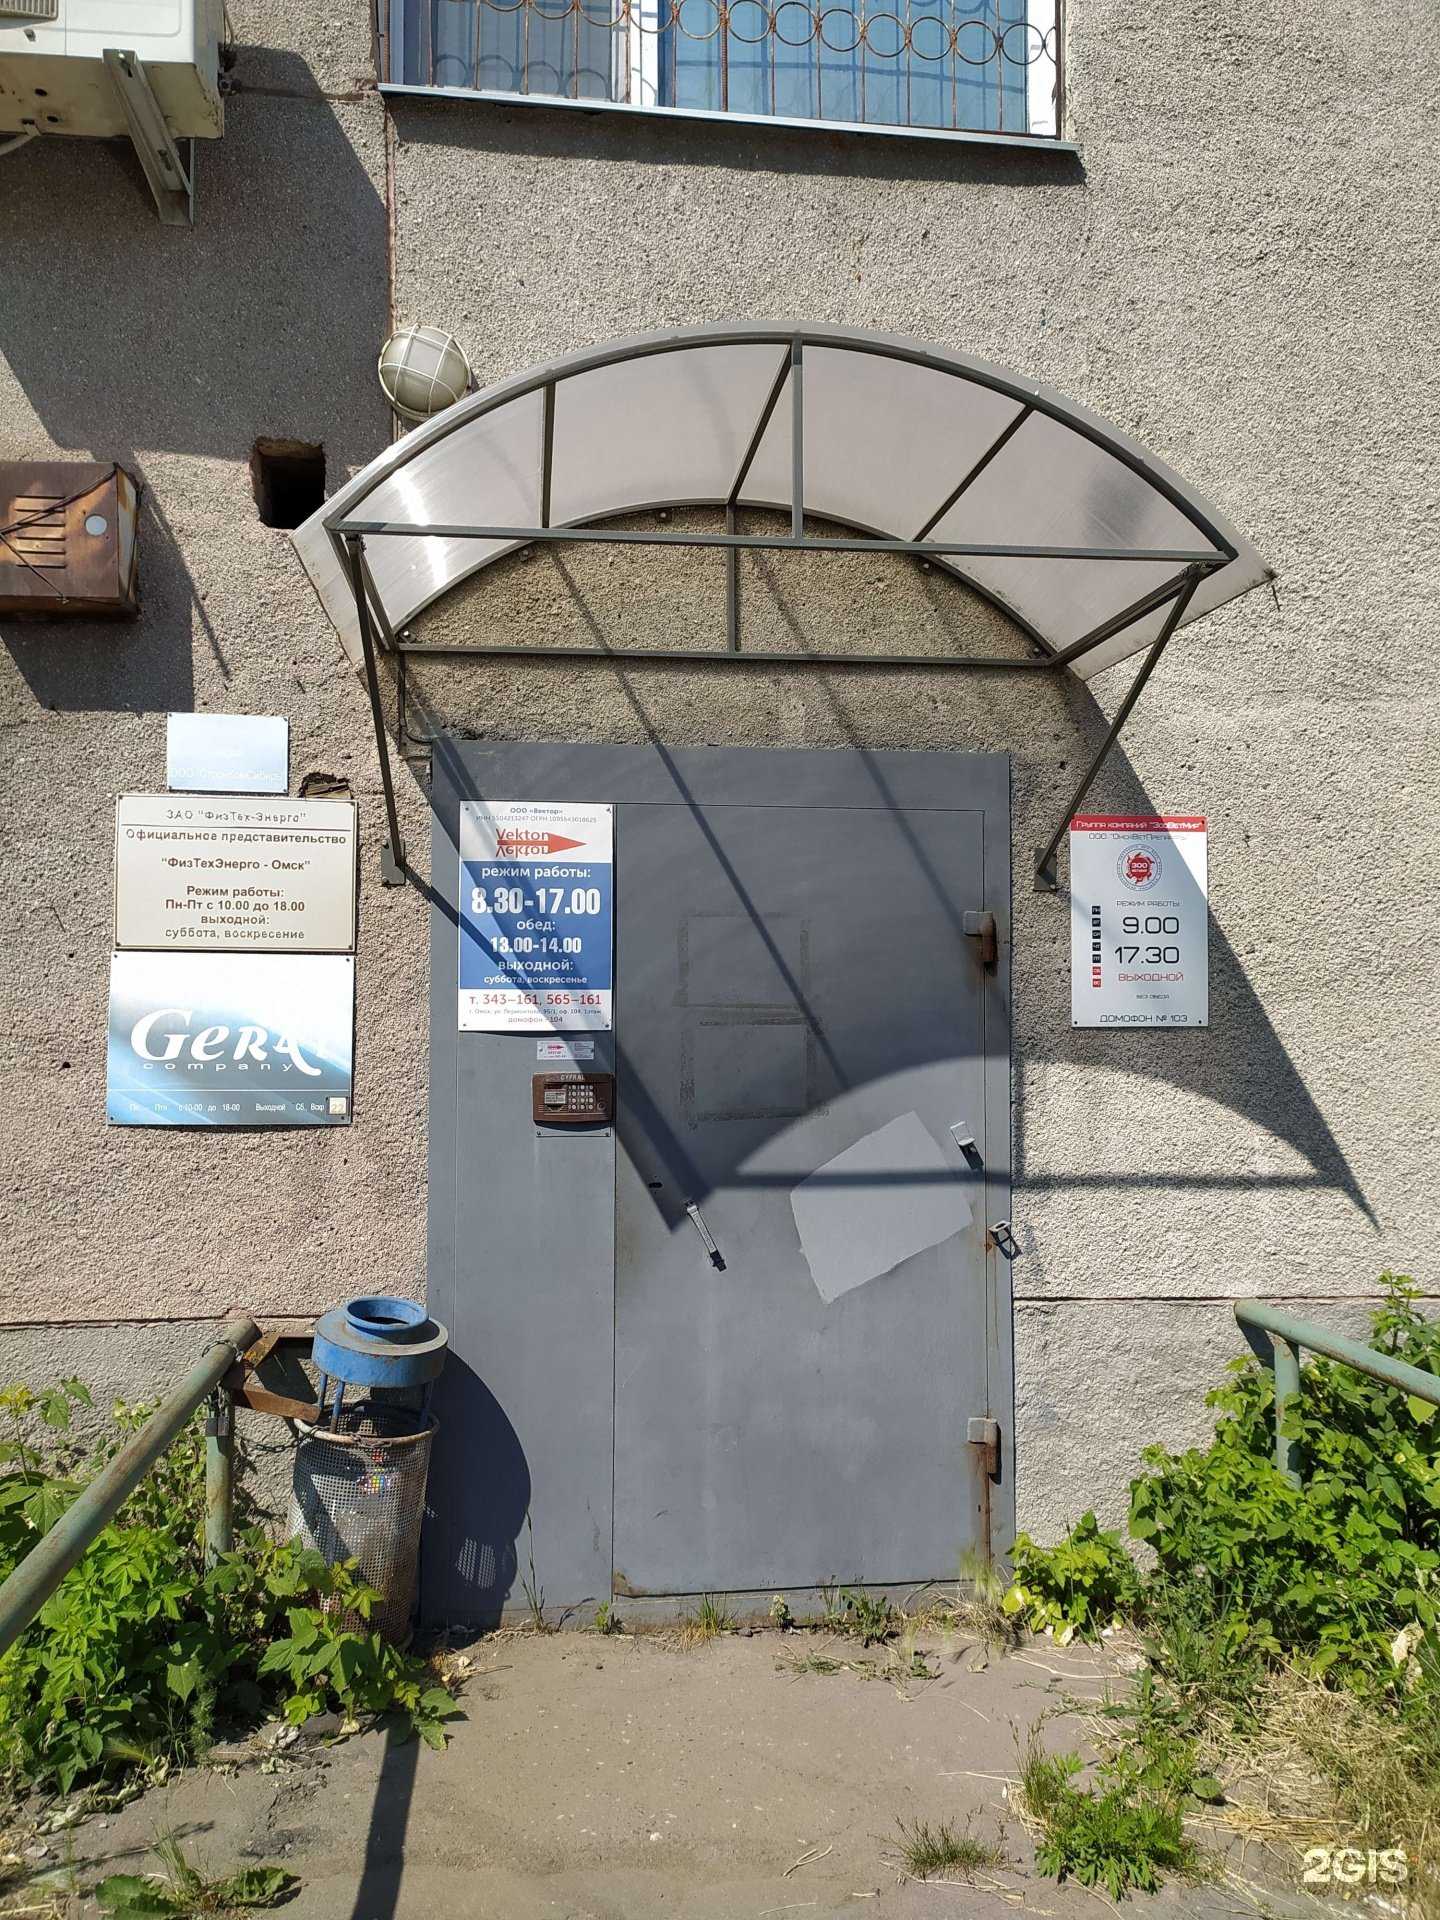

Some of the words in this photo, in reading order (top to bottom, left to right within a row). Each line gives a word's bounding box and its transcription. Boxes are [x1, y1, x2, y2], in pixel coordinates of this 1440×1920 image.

[166, 809, 193, 820] ЗАО
[126, 828, 217, 843] Официальное
[221, 831, 347, 845] представительство
[161, 857, 260, 872] "ФизТехЭнерго
[271, 860, 311, 870] Омск"
[481, 867, 531, 879] режим
[534, 866, 591, 880] работы:
[186, 885, 229, 897] Режим
[232, 887, 285, 899] работы:
[165, 899, 203, 910] Пн-Пт
[206, 902, 214, 910] с
[218, 900, 250, 911] 10.00
[252, 903, 269, 912] до
[273, 901, 306, 912] 18.00
[471, 887, 601, 915] 8.30-17.00
[200, 914, 270, 926] выходной:
[516, 919, 556, 931] обед:
[1122, 916, 1180, 934] 9.00
[165, 927, 220, 941] суббота,
[224, 929, 305, 940] воскресение
[490, 936, 582, 954] 13.00-14.00
[1114, 946, 1180, 964] 17.30
[498, 958, 574, 972] выходной:
[483, 974, 526, 986] суббота,
[1118, 971, 1184, 982] ВЫХОДНОЙ
[1100, 1014, 1153, 1023] ДОМОФОН
[1156, 1014, 1168, 1023] №
[1170, 1014, 1188, 1023] 103
[143, 1063, 294, 1073] company
